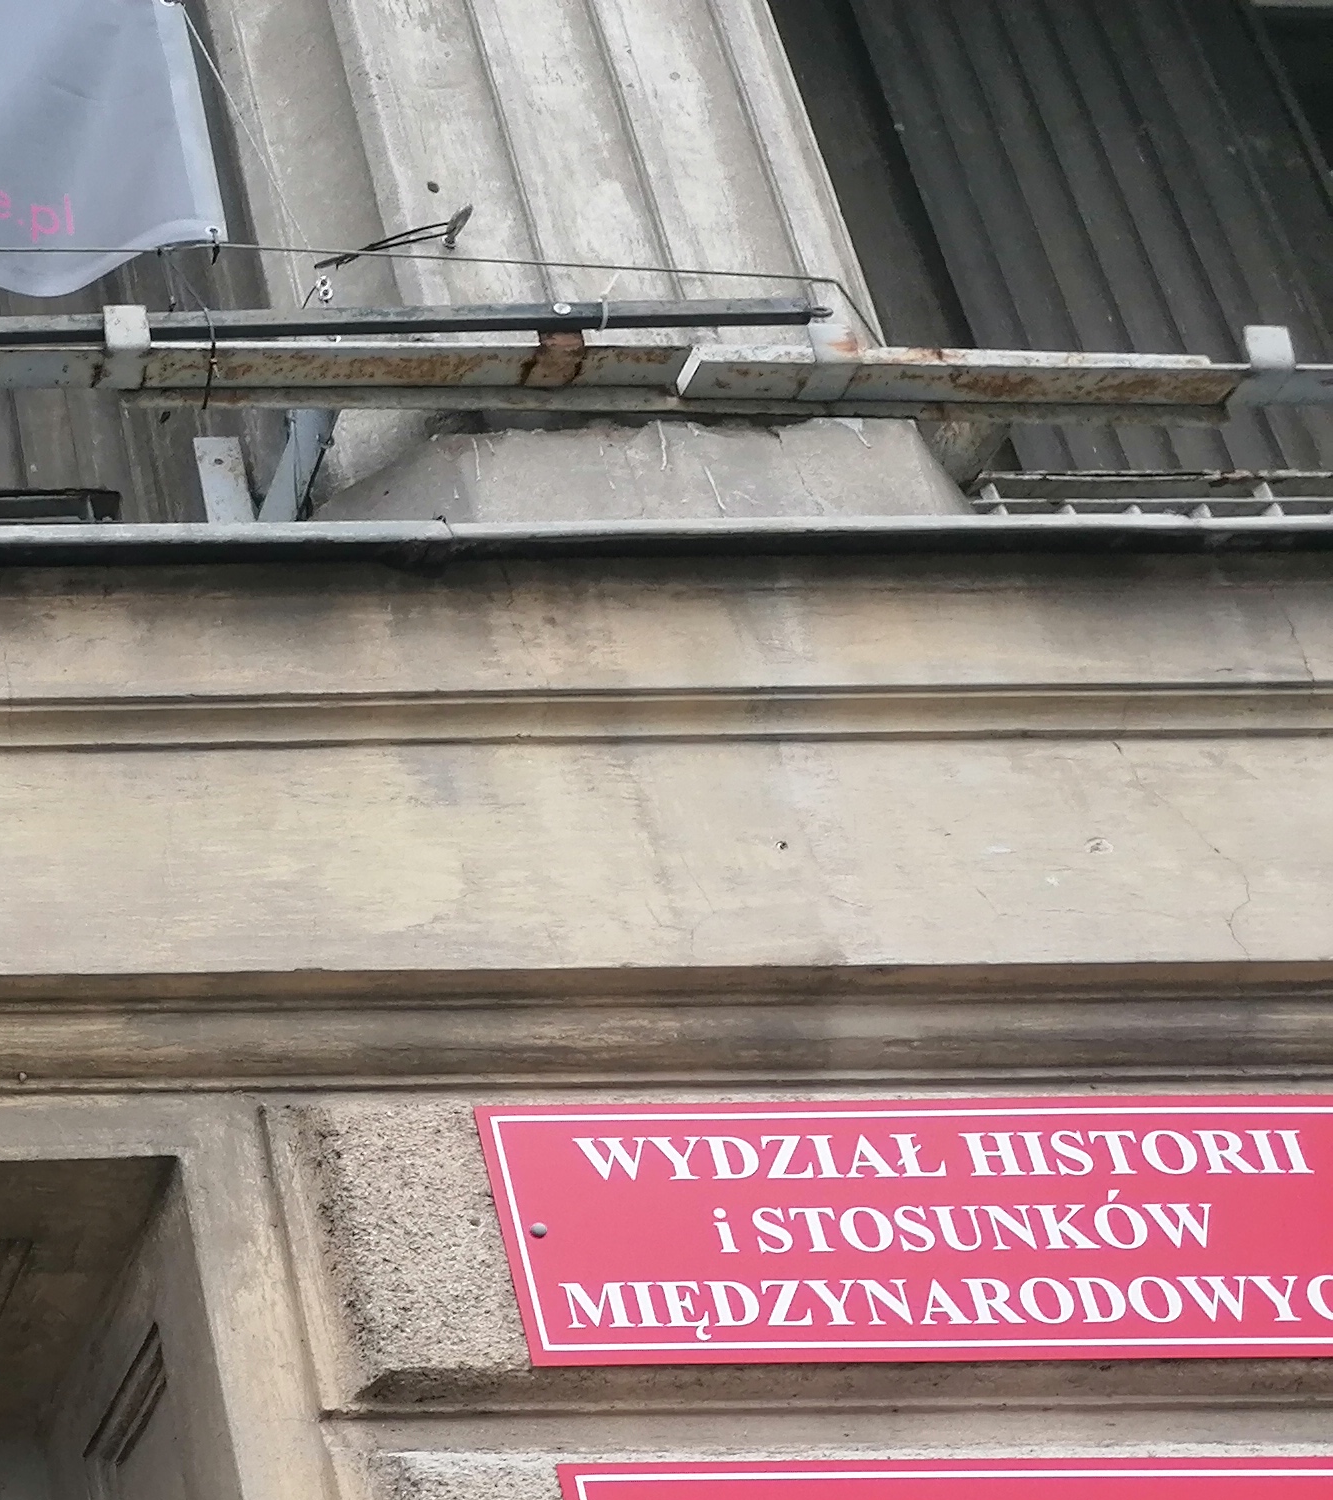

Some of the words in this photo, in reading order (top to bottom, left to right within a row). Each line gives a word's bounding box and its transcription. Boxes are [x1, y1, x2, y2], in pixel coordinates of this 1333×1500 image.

[571, 1133, 947, 1181] WYDZIAŁ
[958, 1129, 1315, 1177] HISTORII
[713, 1207, 741, 1253] i
[754, 1189, 1212, 1254] STOSUNKÓW
